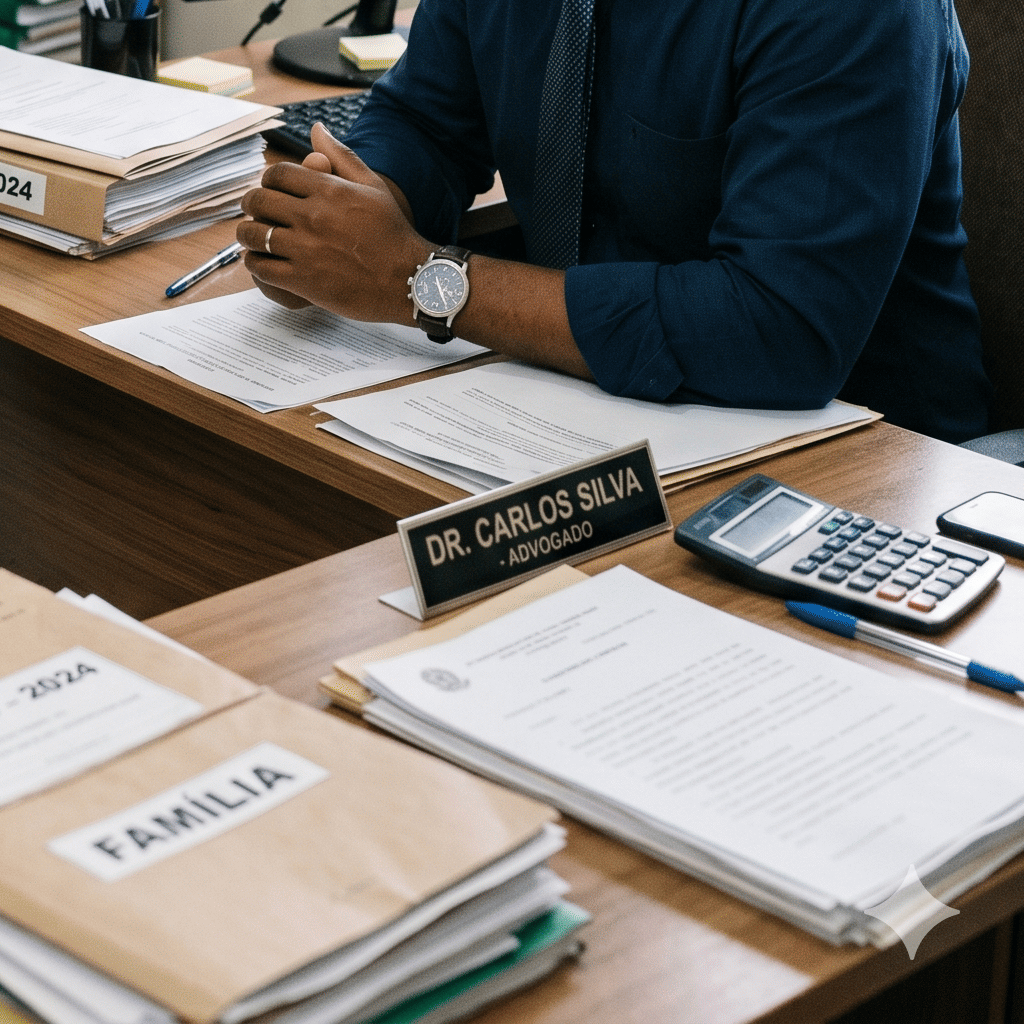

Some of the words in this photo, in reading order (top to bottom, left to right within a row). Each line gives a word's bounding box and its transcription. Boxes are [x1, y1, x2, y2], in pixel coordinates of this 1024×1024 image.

[426, 528, 471, 566] DR.
[475, 489, 573, 548] CARLOS
[576, 467, 643, 511] SILVA
[509, 520, 593, 566] ADVOGADO
[19, 662, 98, 700] 2024
[93, 766, 294, 860] FAMÍLIA
